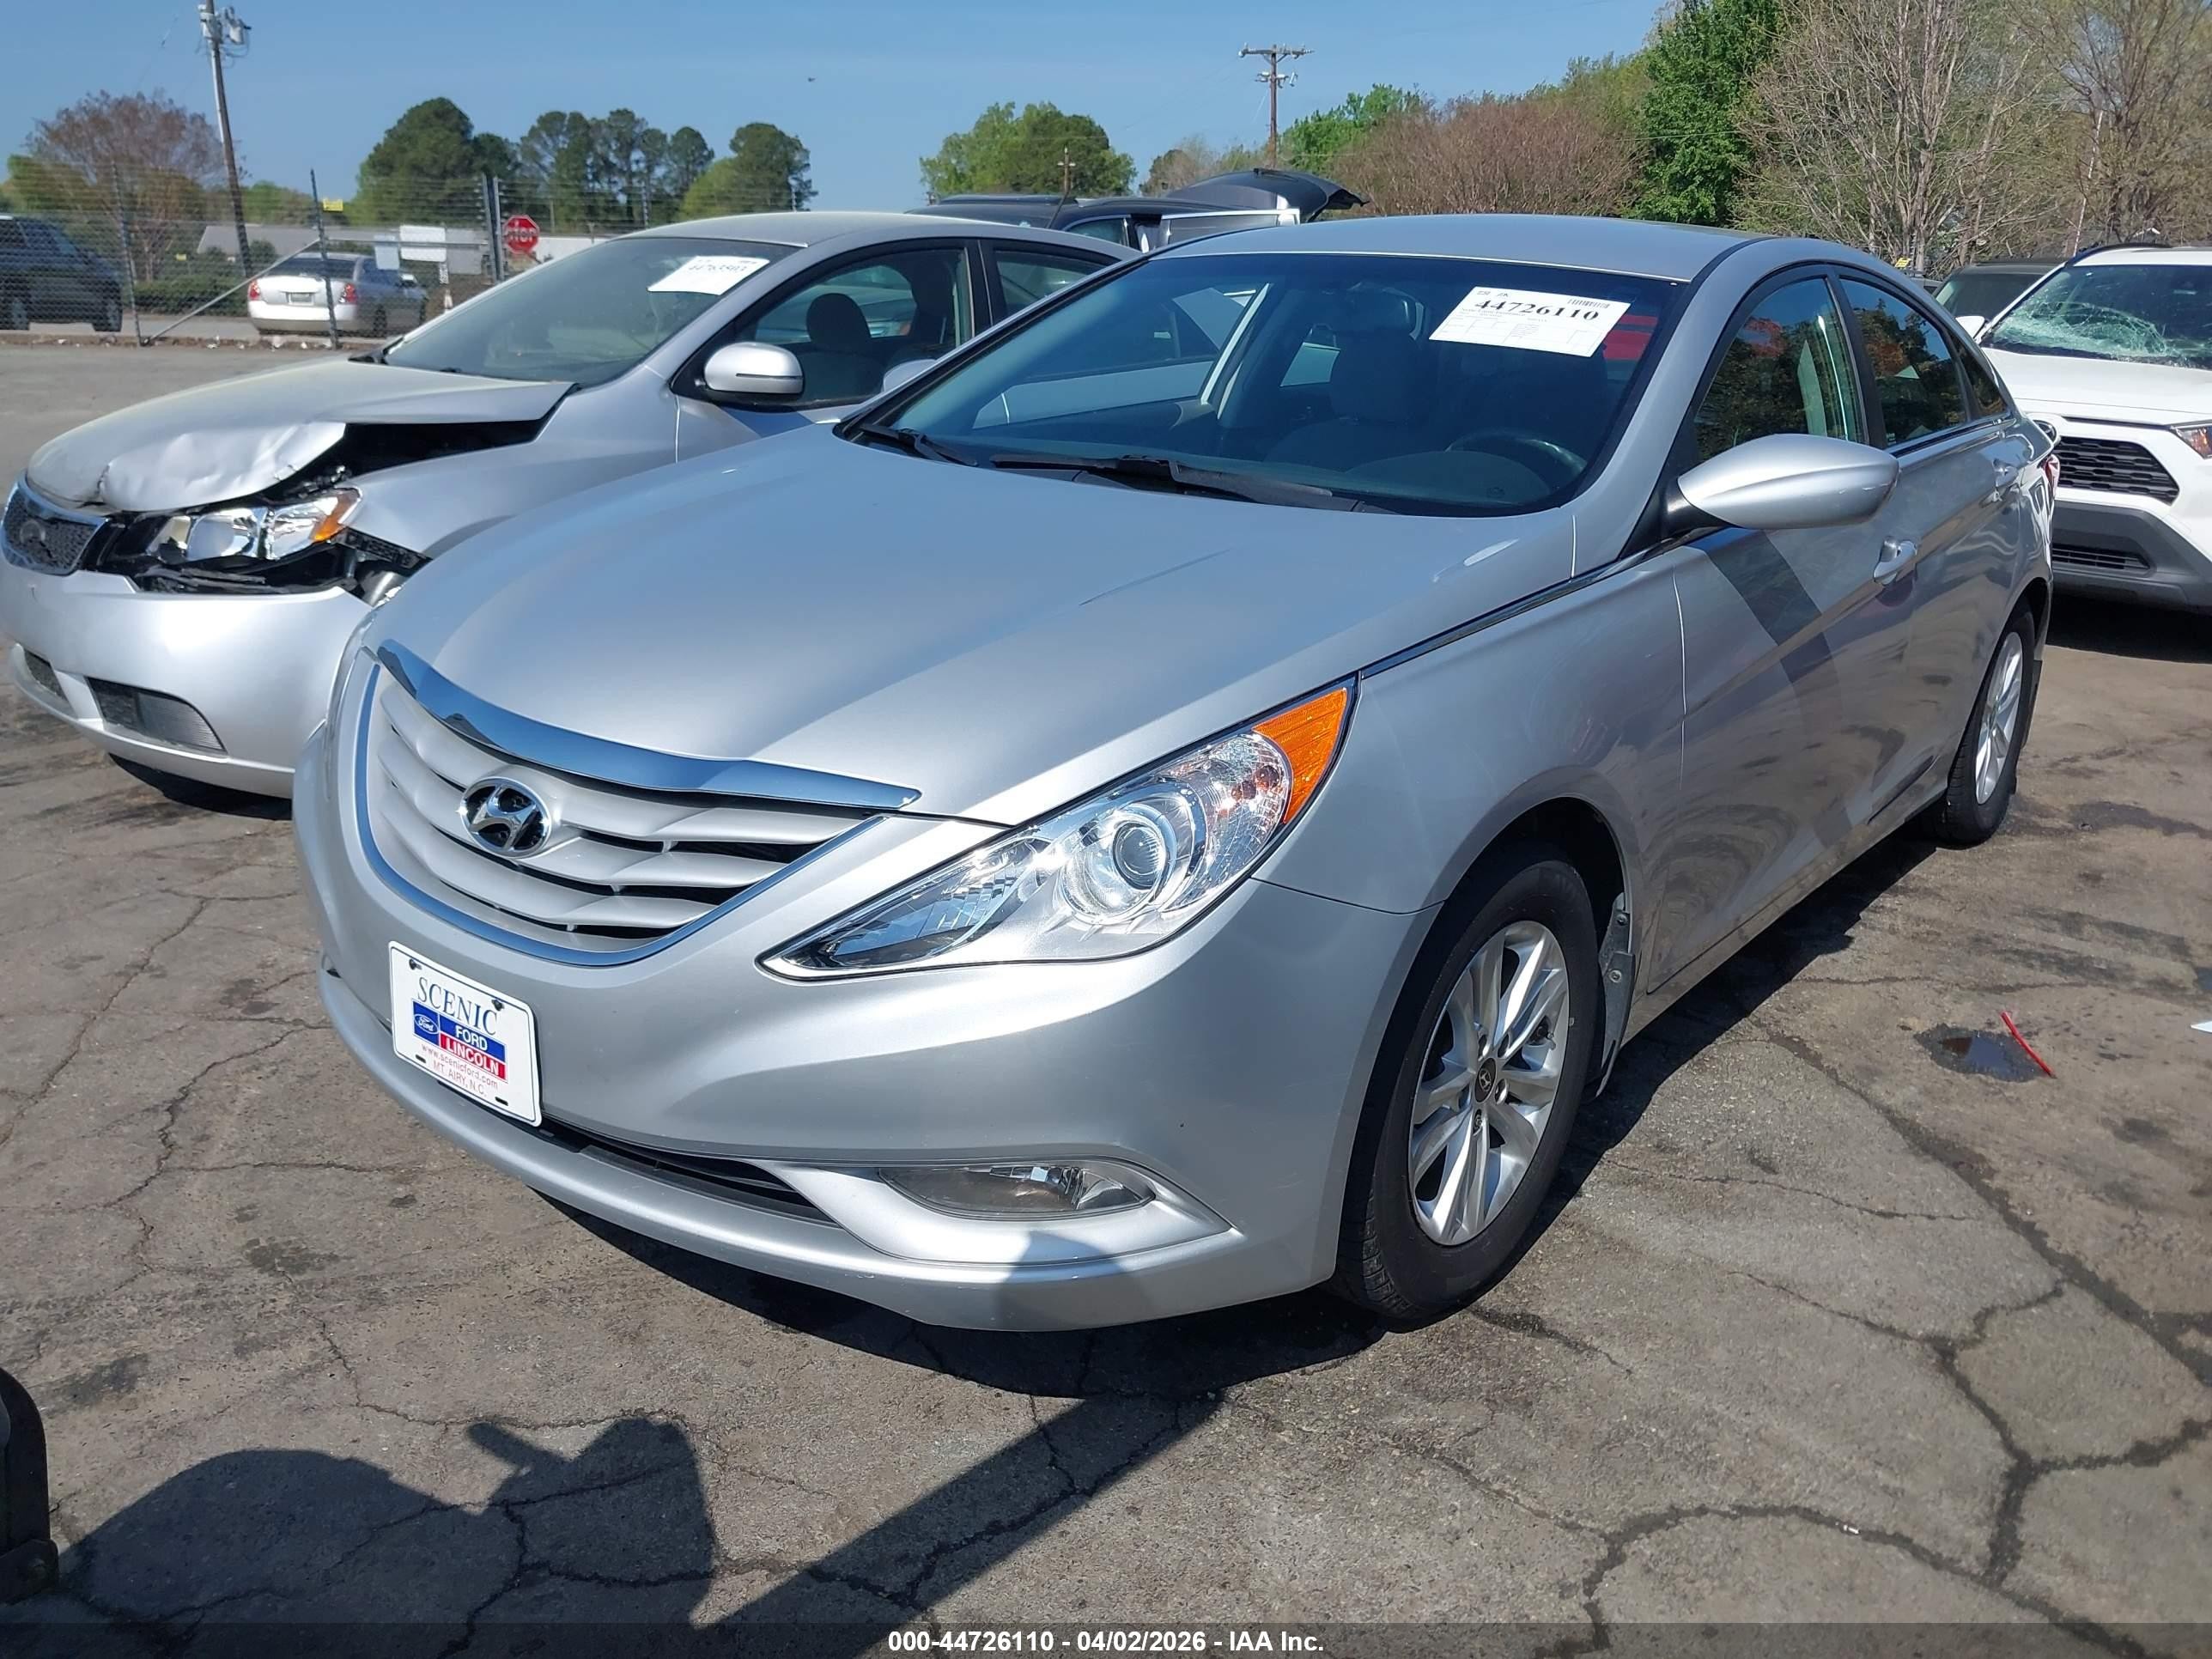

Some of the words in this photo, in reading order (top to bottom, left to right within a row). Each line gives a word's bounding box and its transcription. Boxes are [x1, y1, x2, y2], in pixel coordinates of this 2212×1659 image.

[1474, 300, 1600, 321] 44726110
[417, 976, 497, 1036] SCENIC
[446, 1037, 499, 1076] LINCOLN
[455, 1025, 488, 1051] FORD
[422, 1043, 498, 1089] www.scenicford.com
